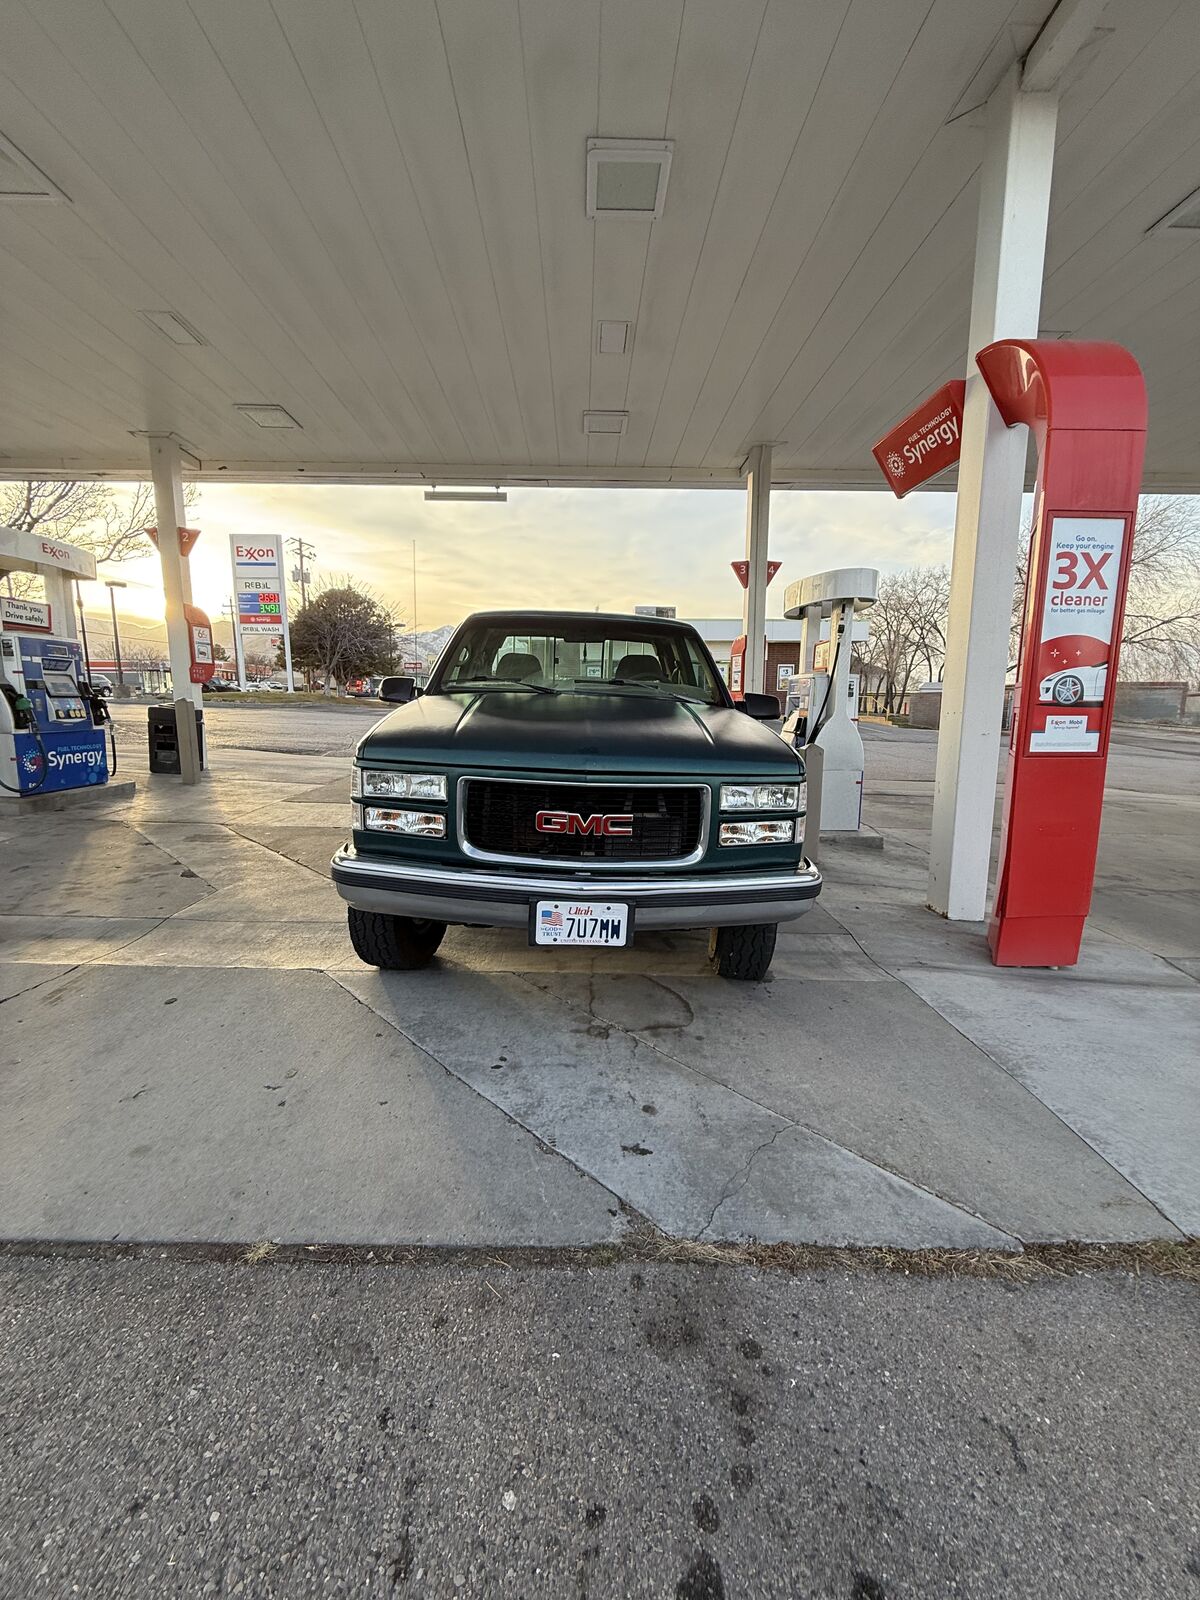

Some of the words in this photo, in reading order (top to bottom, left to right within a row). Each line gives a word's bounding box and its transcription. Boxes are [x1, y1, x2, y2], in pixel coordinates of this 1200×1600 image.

[908, 433, 920, 444] FUEL
[920, 406, 953, 436] TECHNOLOGY
[904, 416, 959, 464] Synergy
[182, 533, 188, 542] 2
[42, 543, 70, 560] Exxon
[236, 546, 274, 560] Exxon
[1092, 542, 1114, 551] engine
[740, 566, 746, 574] 3
[768, 566, 774, 574] 4
[1052, 552, 1112, 590] 3X
[6, 601, 28, 611] Thank
[1051, 592, 1108, 606] cleaner
[6, 611, 24, 620] Drive
[25, 615, 45, 624] safely.
[48, 751, 102, 770] Synergy
[536, 810, 634, 836] GMC
[568, 906, 593, 916] Utah
[566, 918, 620, 940] 7U7MW
